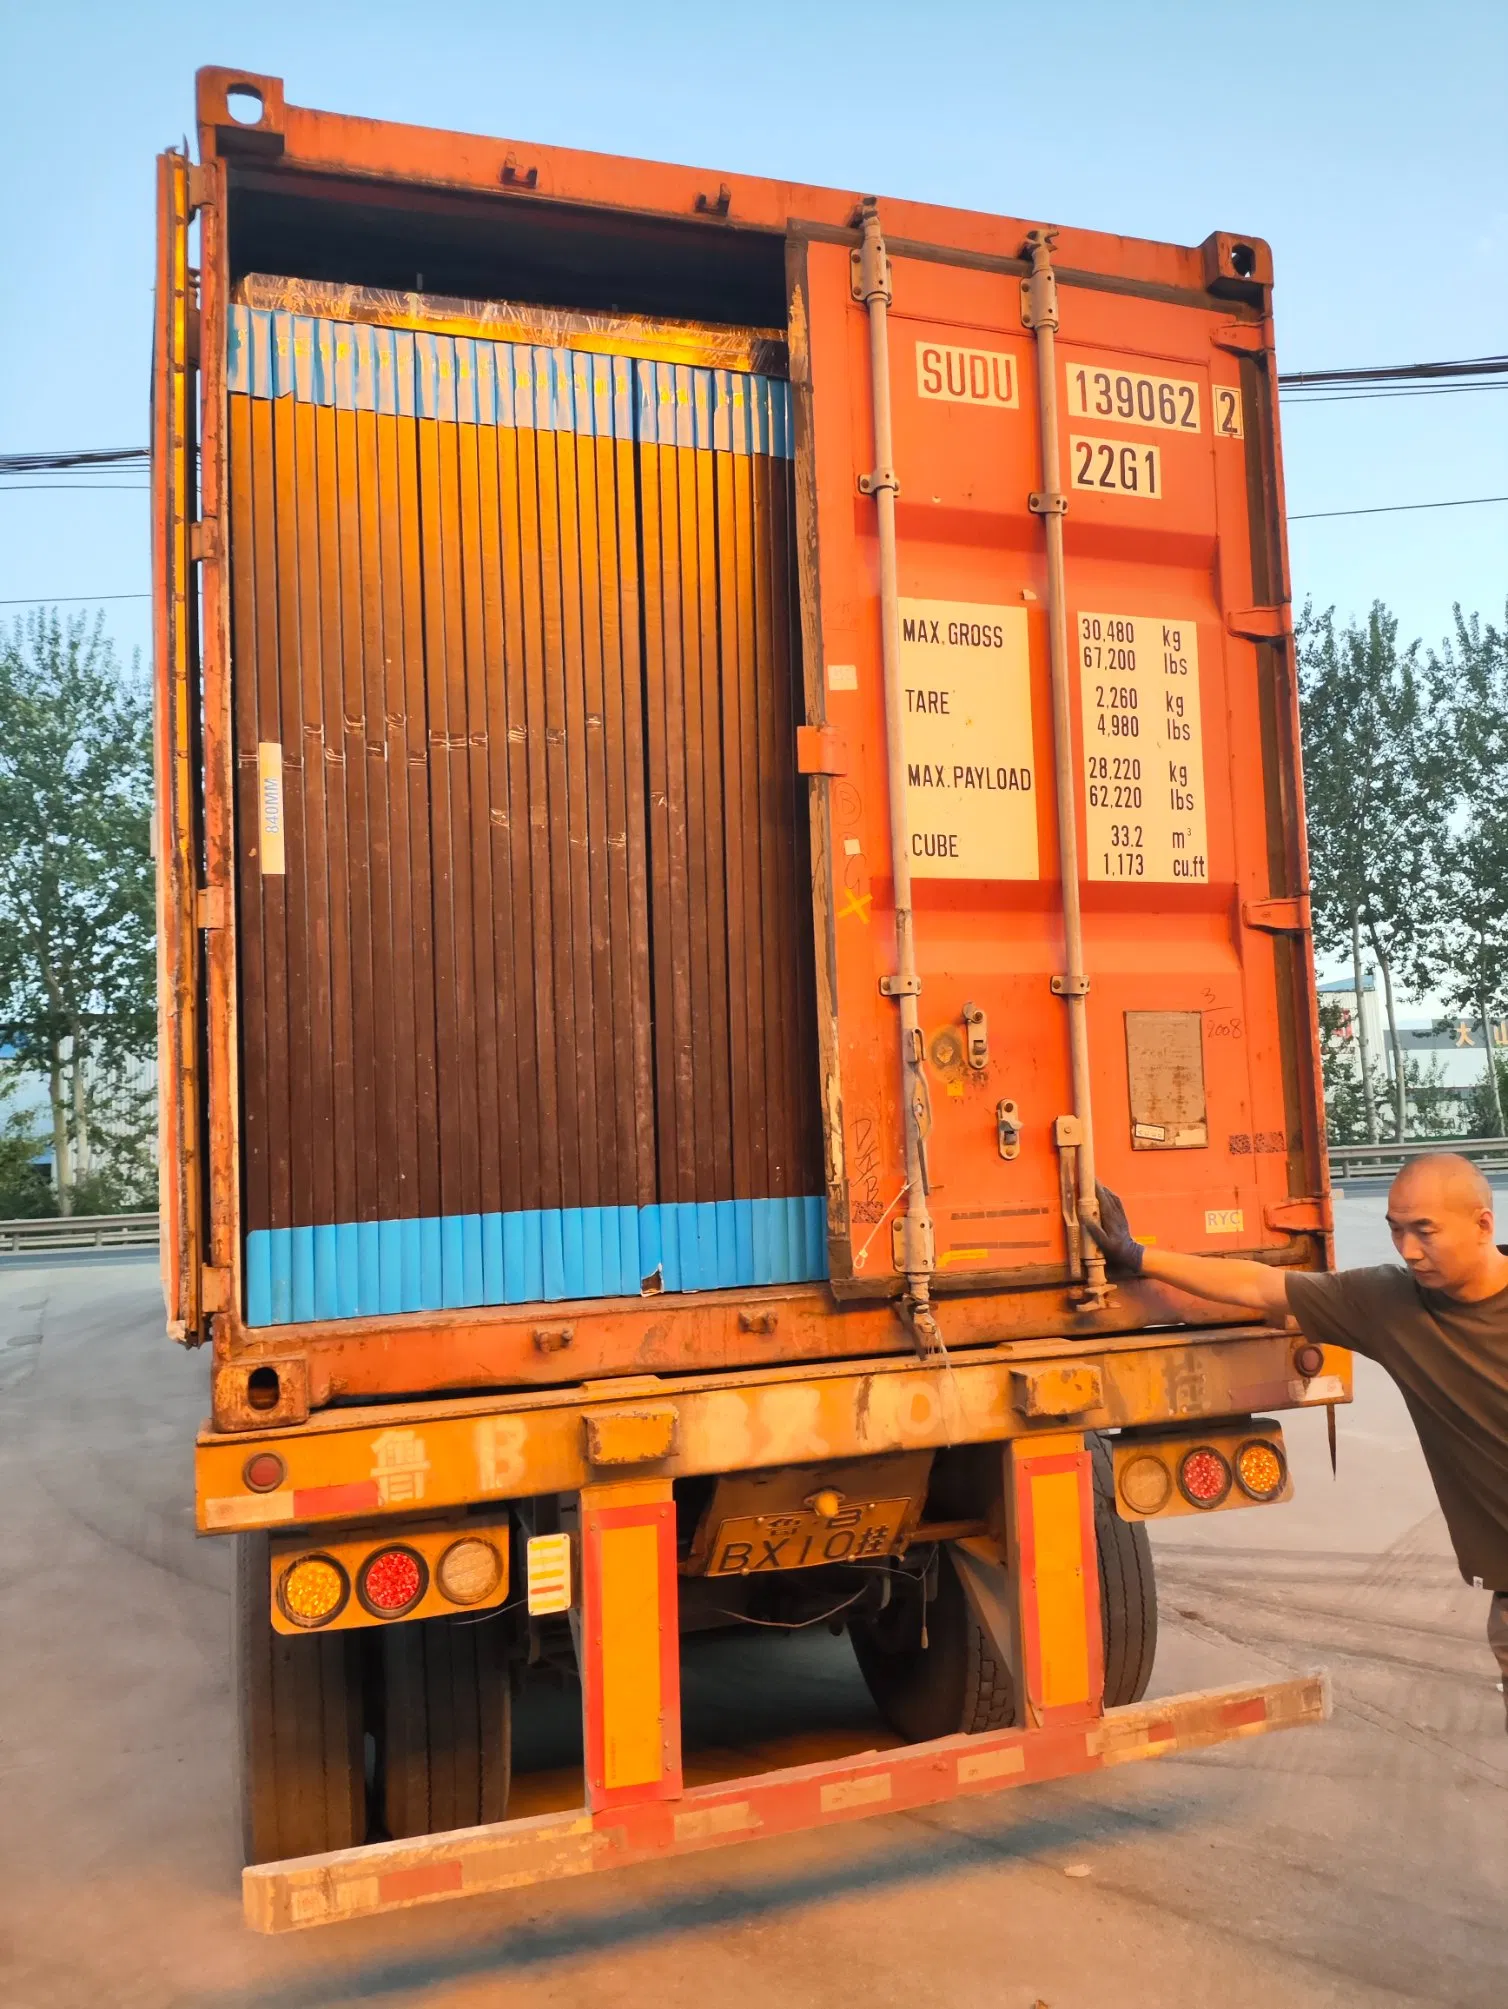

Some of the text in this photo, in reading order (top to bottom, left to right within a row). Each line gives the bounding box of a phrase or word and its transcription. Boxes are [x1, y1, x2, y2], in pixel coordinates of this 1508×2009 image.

[922, 348, 1238, 433] SUDU 139062 2
[1075, 441, 1156, 493] 22G1
[1163, 625, 1181, 651] kg
[1164, 653, 1188, 675] lbs
[905, 689, 950, 714] TARE
[1166, 690, 1184, 717] kg
[1167, 718, 1190, 741] lbs
[1170, 761, 1187, 787] kg
[263, 777, 280, 834] 840MM
[1171, 789, 1194, 811] lbs
[912, 833, 960, 858] CUBE
[1111, 824, 1144, 848] 33.2
